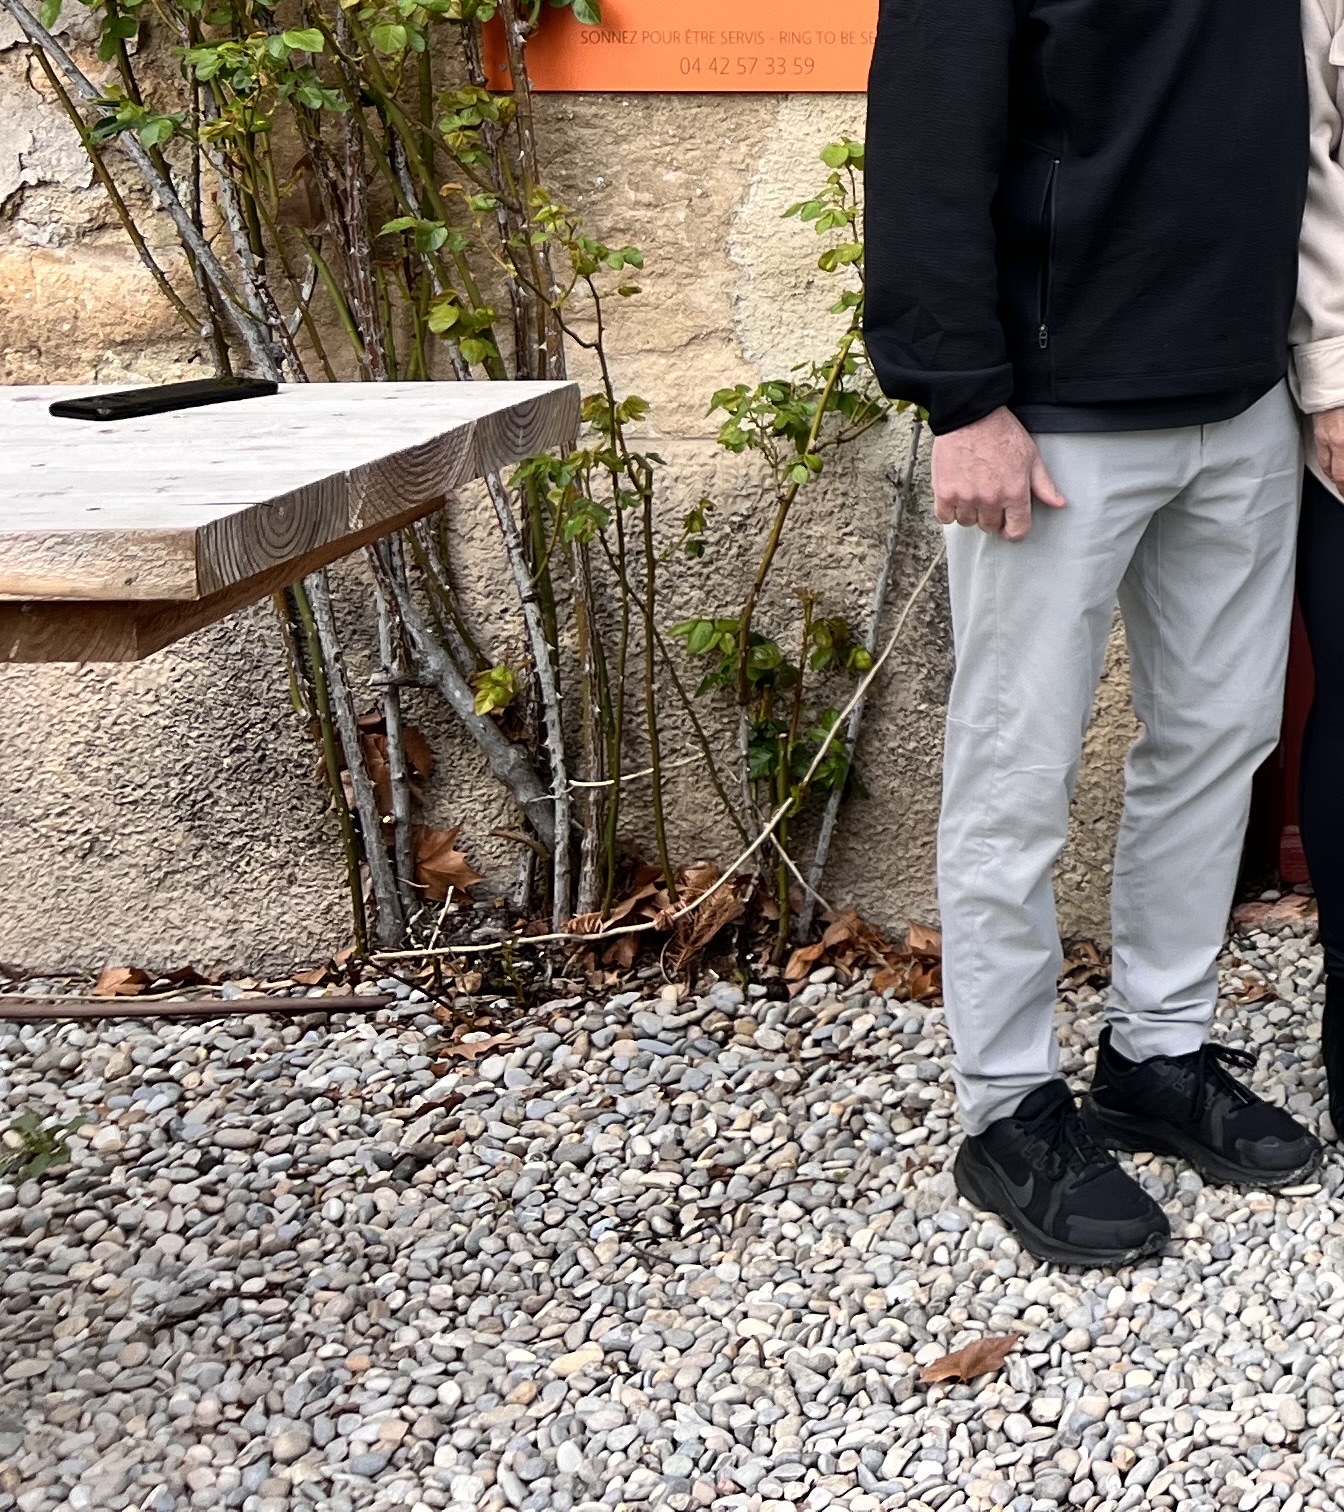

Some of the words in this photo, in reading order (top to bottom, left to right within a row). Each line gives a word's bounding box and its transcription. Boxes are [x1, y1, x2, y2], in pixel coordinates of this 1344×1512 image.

[580, 30, 638, 46] SONNEZ
[641, 30, 681, 45] POUR
[684, 28, 716, 45] ÊTRE
[719, 30, 766, 46] SERVIS
[779, 30, 812, 46] RING
[814, 30, 837, 45] TO
[840, 30, 857, 45] BE
[679, 56, 701, 75] 04
[707, 56, 730, 76] 42
[736, 56, 758, 76] 57
[764, 56, 787, 76] 33
[792, 56, 815, 76] 59
